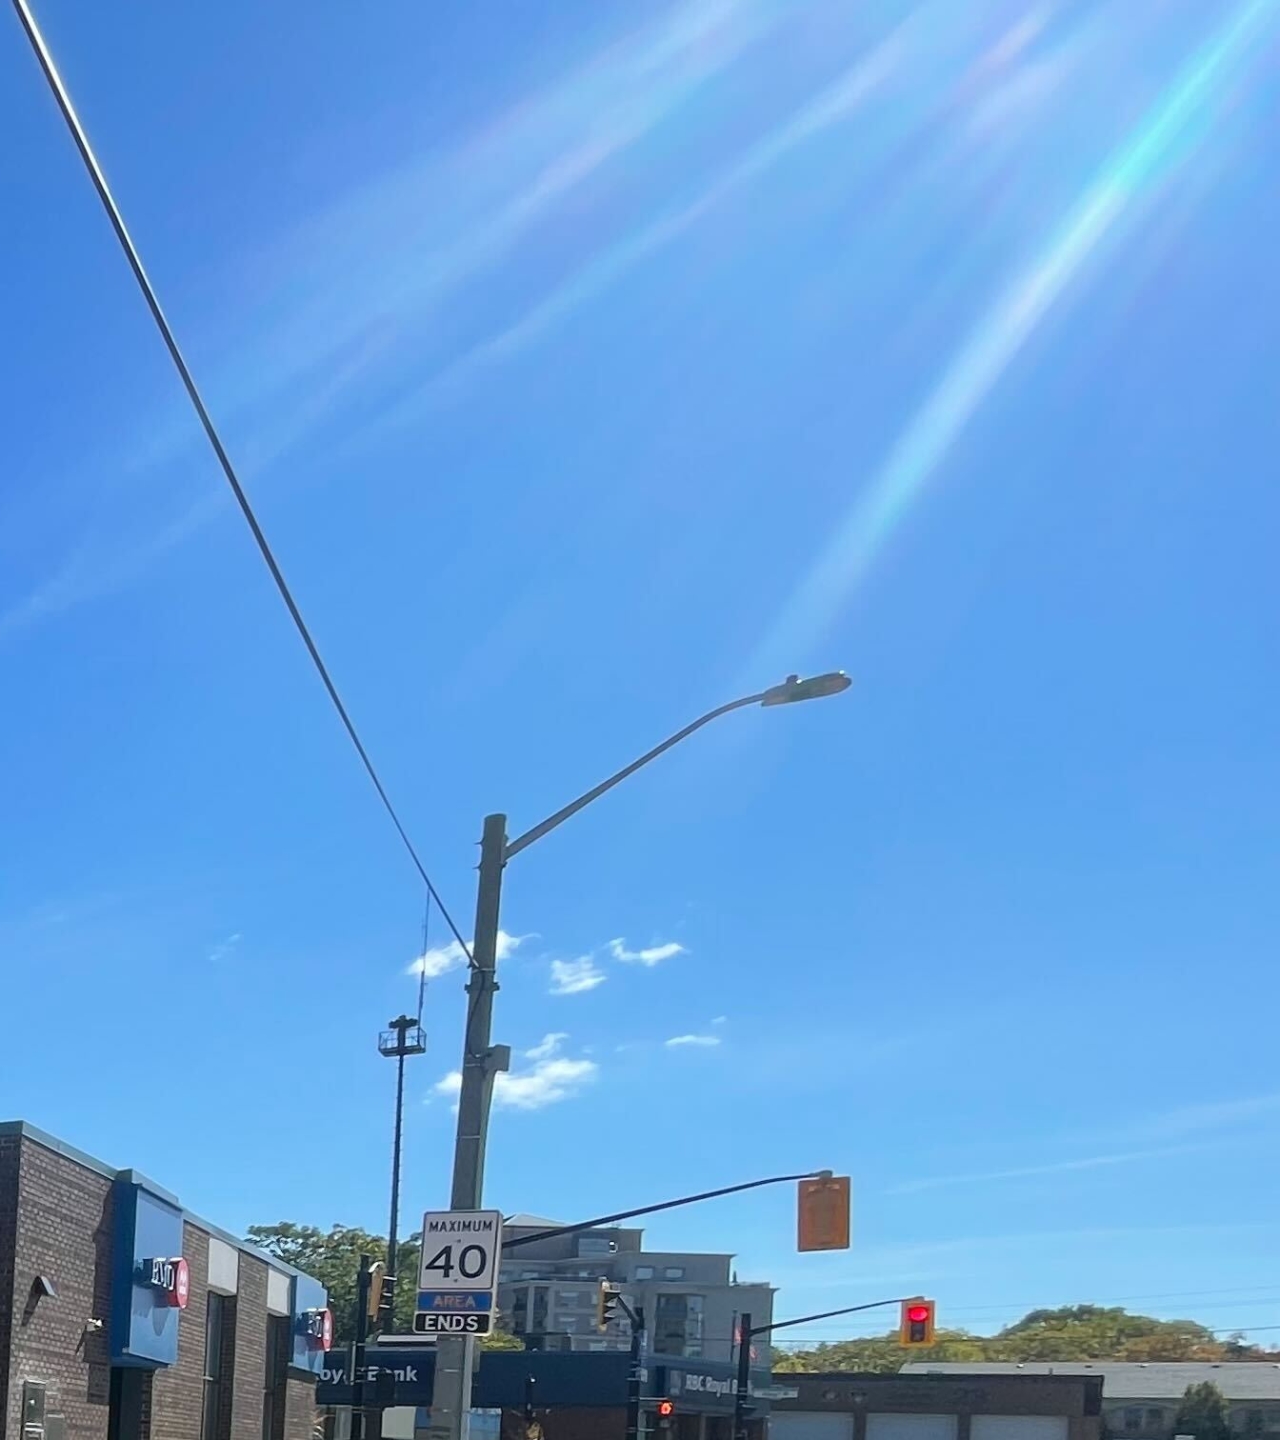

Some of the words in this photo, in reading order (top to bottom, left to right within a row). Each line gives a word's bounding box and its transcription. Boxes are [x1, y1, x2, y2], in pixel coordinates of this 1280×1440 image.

[429, 1220, 494, 1233] MAXIMUM
[425, 1244, 488, 1279] 40
[433, 1295, 476, 1308] AREA
[424, 1315, 479, 1332] ENDS
[706, 1376, 731, 1398] Royal
